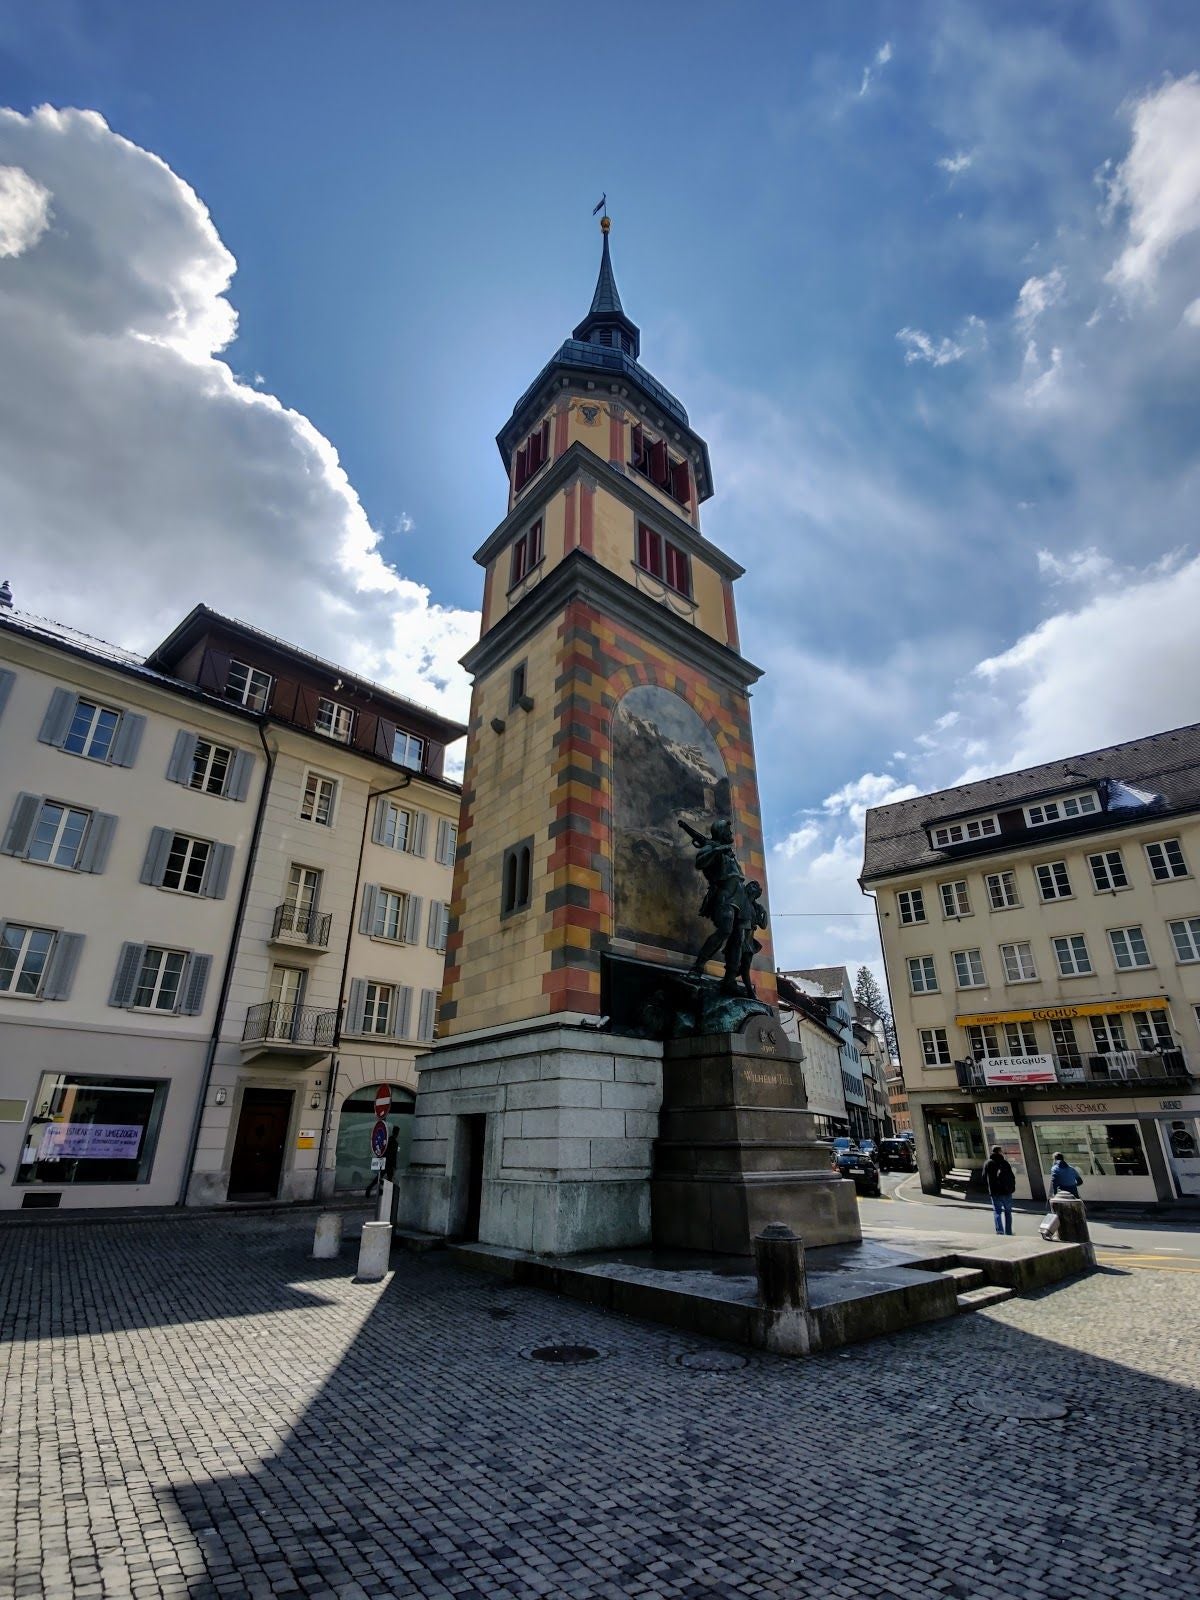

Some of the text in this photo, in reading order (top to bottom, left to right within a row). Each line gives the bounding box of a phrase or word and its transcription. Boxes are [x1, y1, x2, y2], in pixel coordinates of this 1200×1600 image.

[1032, 1007, 1078, 1020] EGGHUS
[988, 1056, 1047, 1067] CAFE EGGHUS
